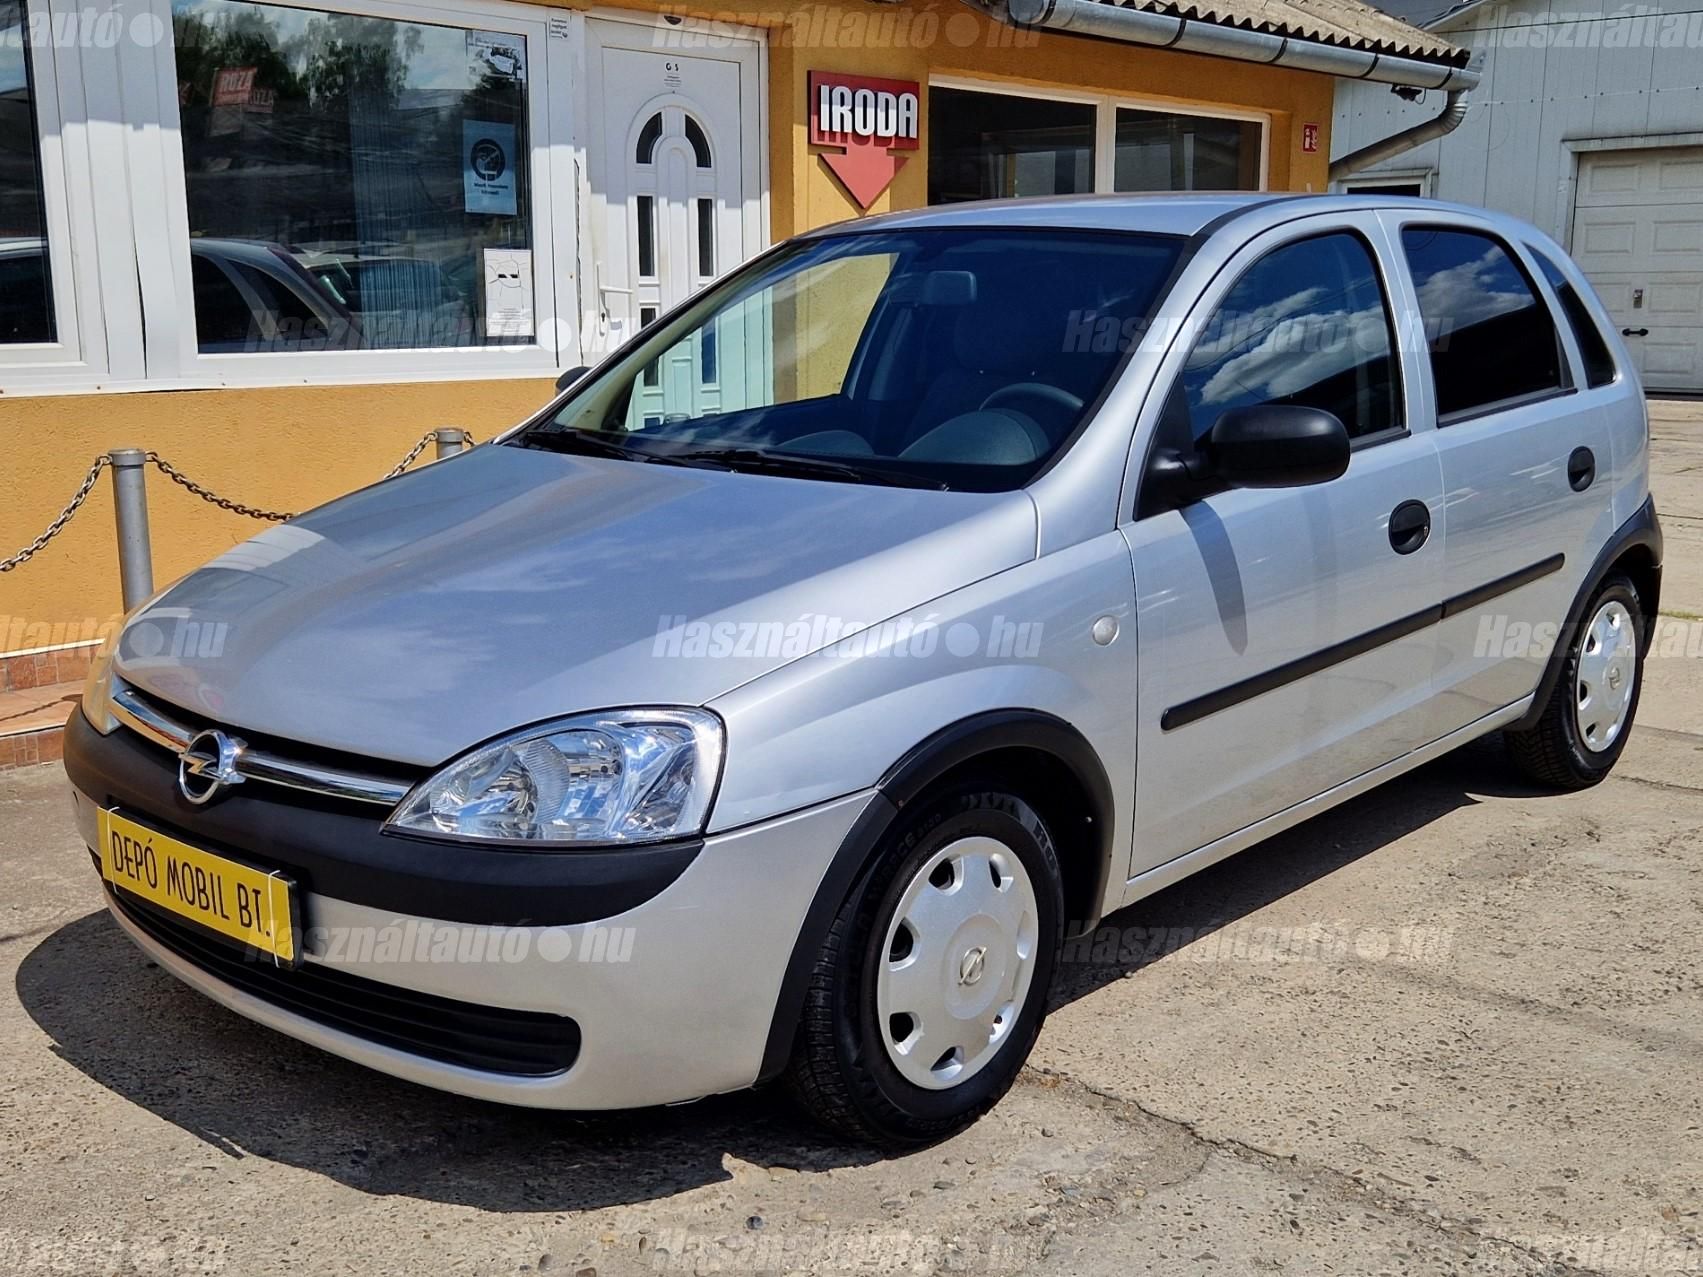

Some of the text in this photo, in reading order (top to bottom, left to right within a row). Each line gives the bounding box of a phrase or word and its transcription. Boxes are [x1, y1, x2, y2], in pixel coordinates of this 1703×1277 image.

[820, 85, 918, 139] IRODA
[111, 831, 271, 937] DEPÓ MOBIL BT.
